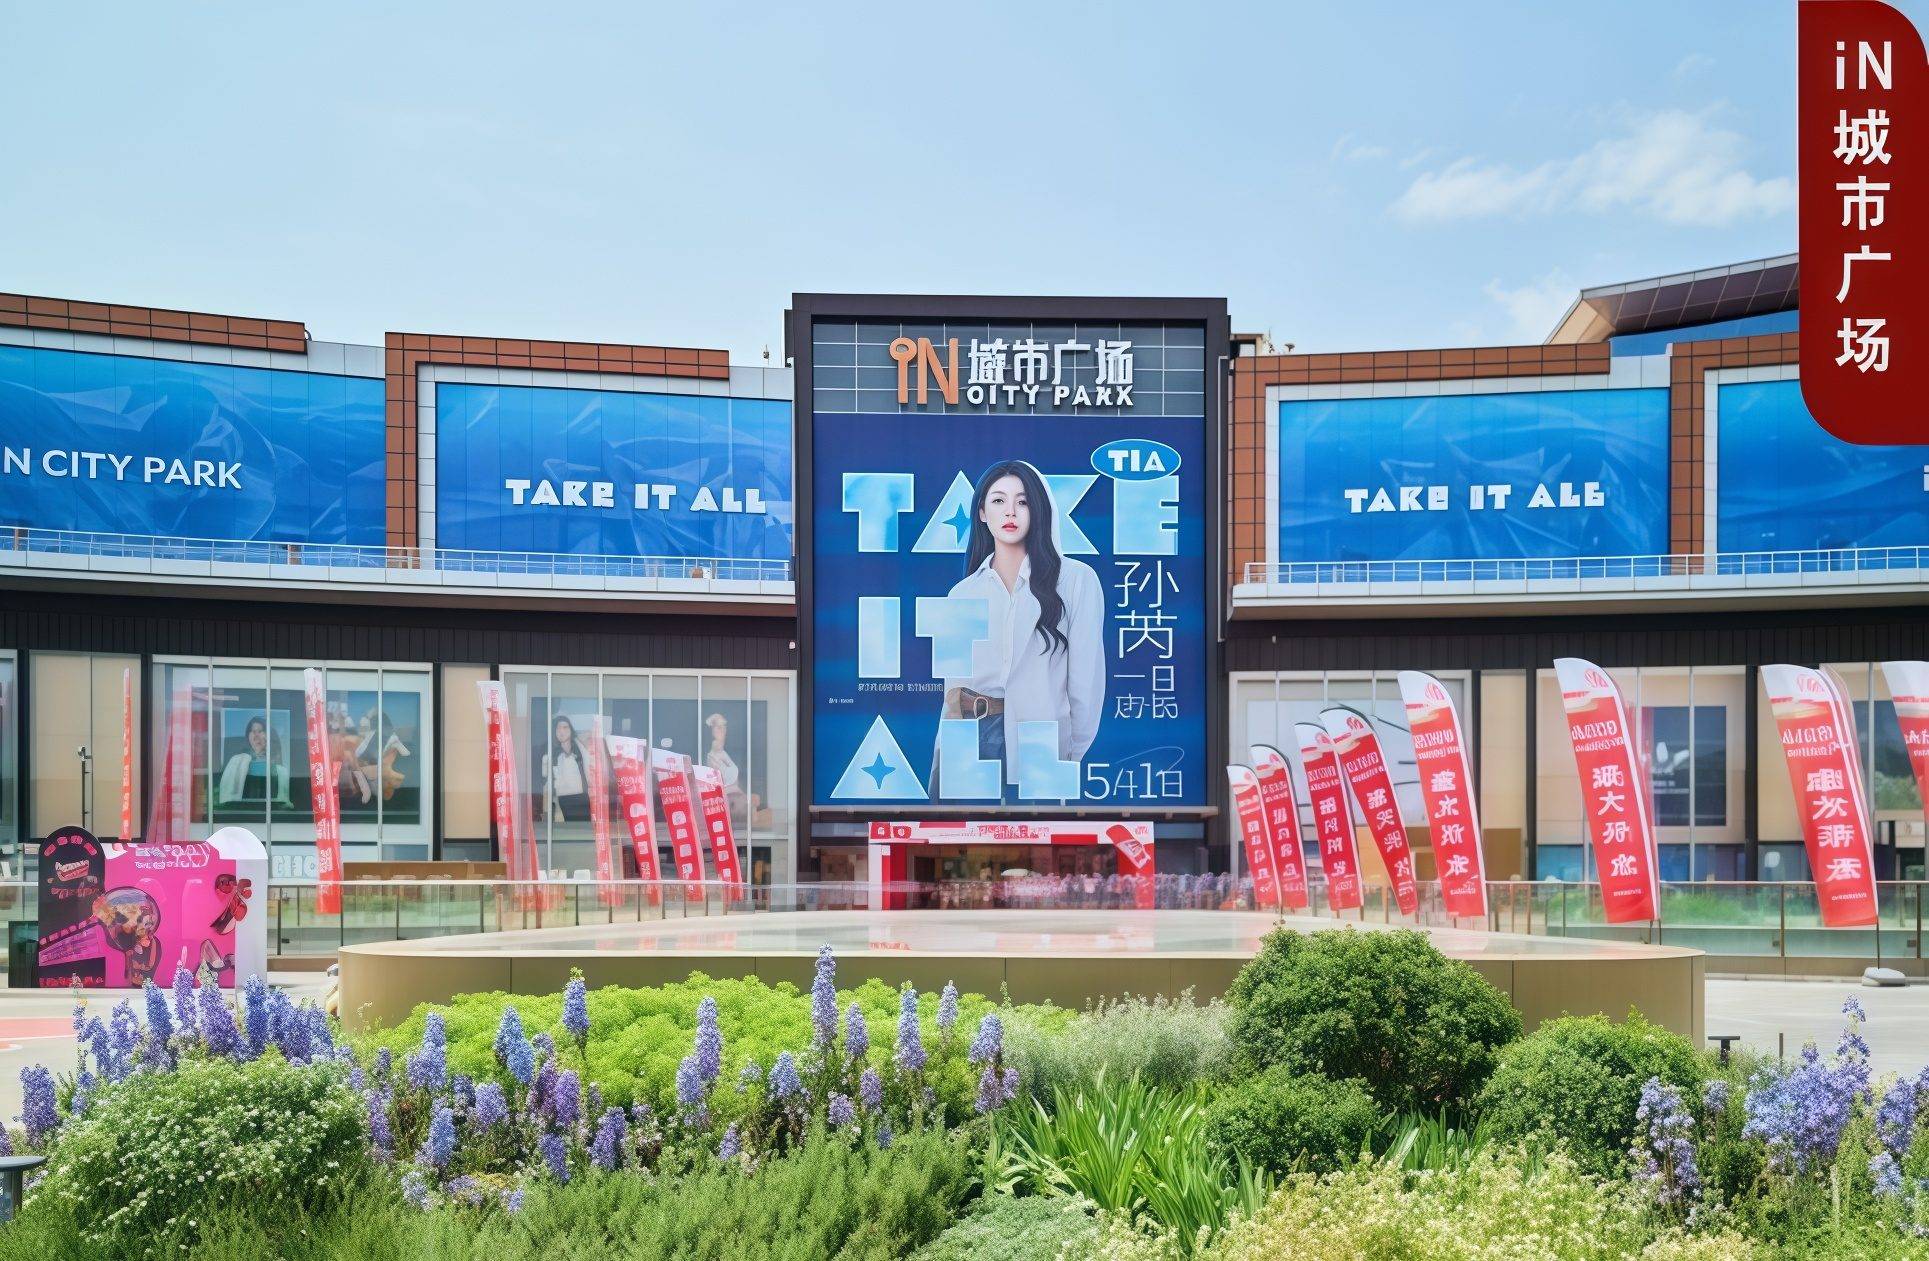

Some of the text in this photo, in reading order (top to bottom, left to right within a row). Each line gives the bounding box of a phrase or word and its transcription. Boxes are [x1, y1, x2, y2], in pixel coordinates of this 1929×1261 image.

[42, 449, 133, 481] CITY
[143, 456, 242, 489] PARK
[505, 479, 767, 514] TAKE IT ALL
[1469, 484, 1512, 510] IT
[858, 596, 990, 678] IT
[829, 714, 1081, 800] ALL
